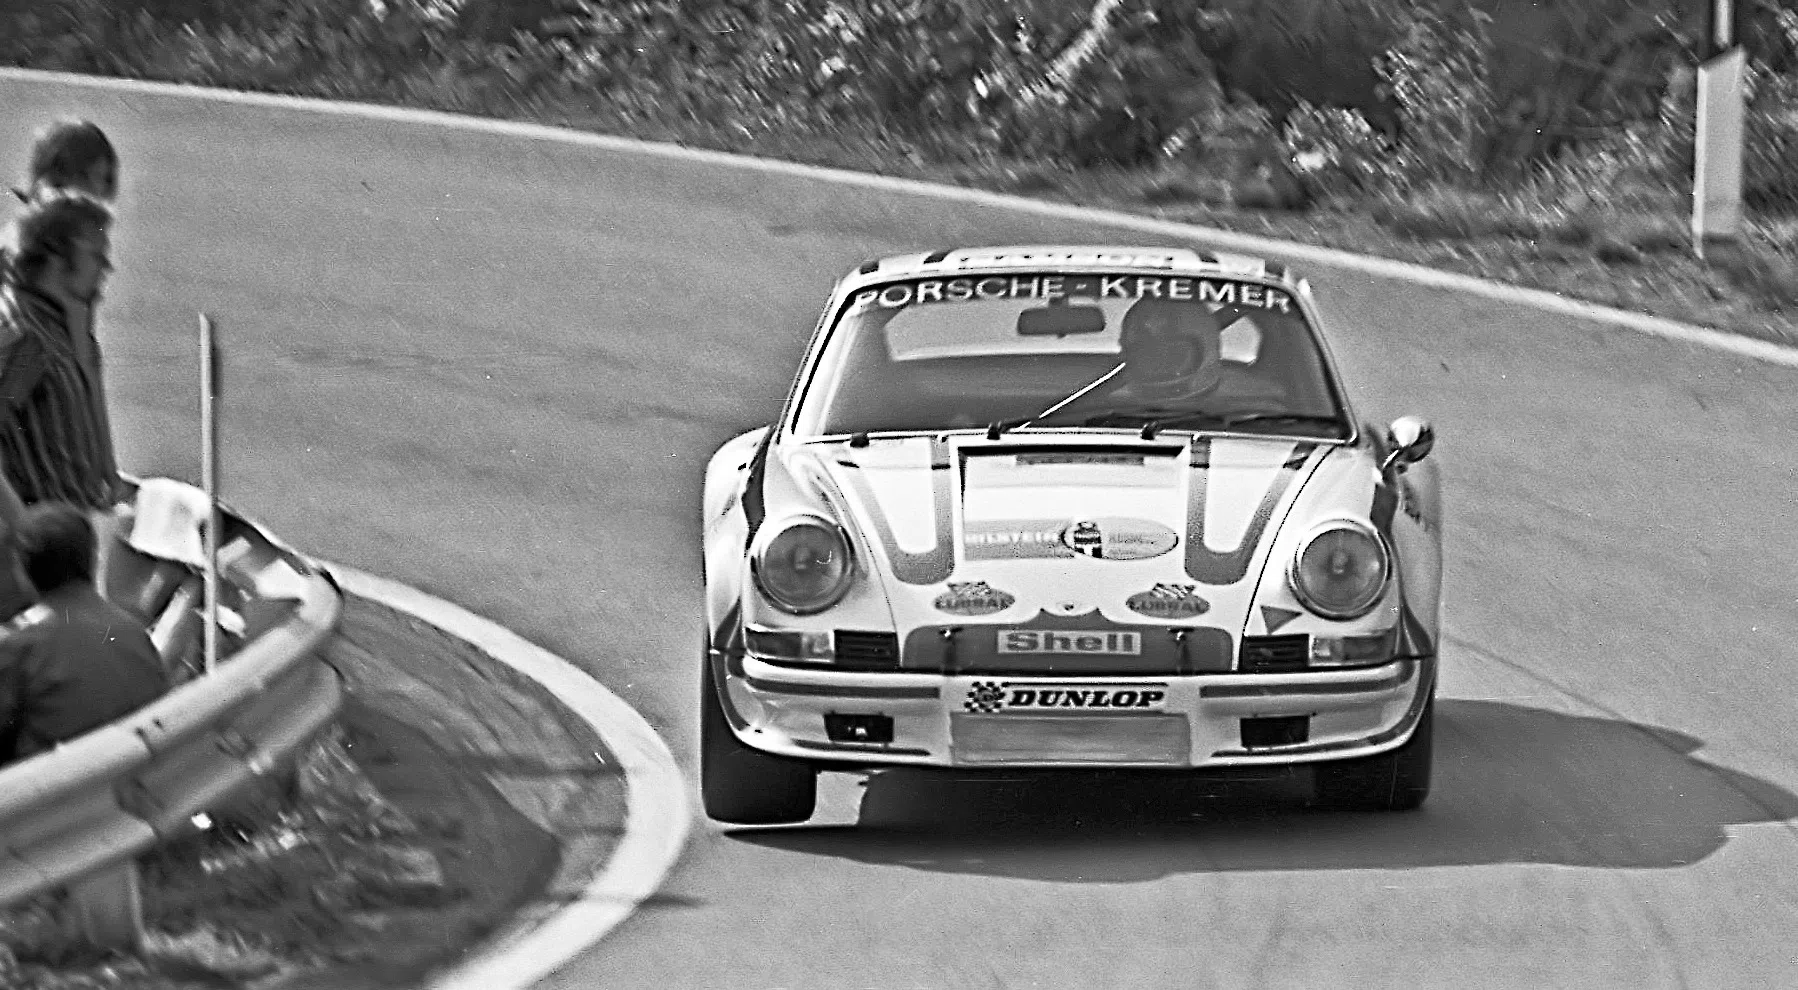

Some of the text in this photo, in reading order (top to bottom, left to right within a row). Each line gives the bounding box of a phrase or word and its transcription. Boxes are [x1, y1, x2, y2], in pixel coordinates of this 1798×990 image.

[855, 275, 1065, 311] PORSCHE
[1101, 276, 1290, 313] KREMER
[1006, 632, 1134, 651] Shell
[1008, 690, 1165, 707] DUNLOP
